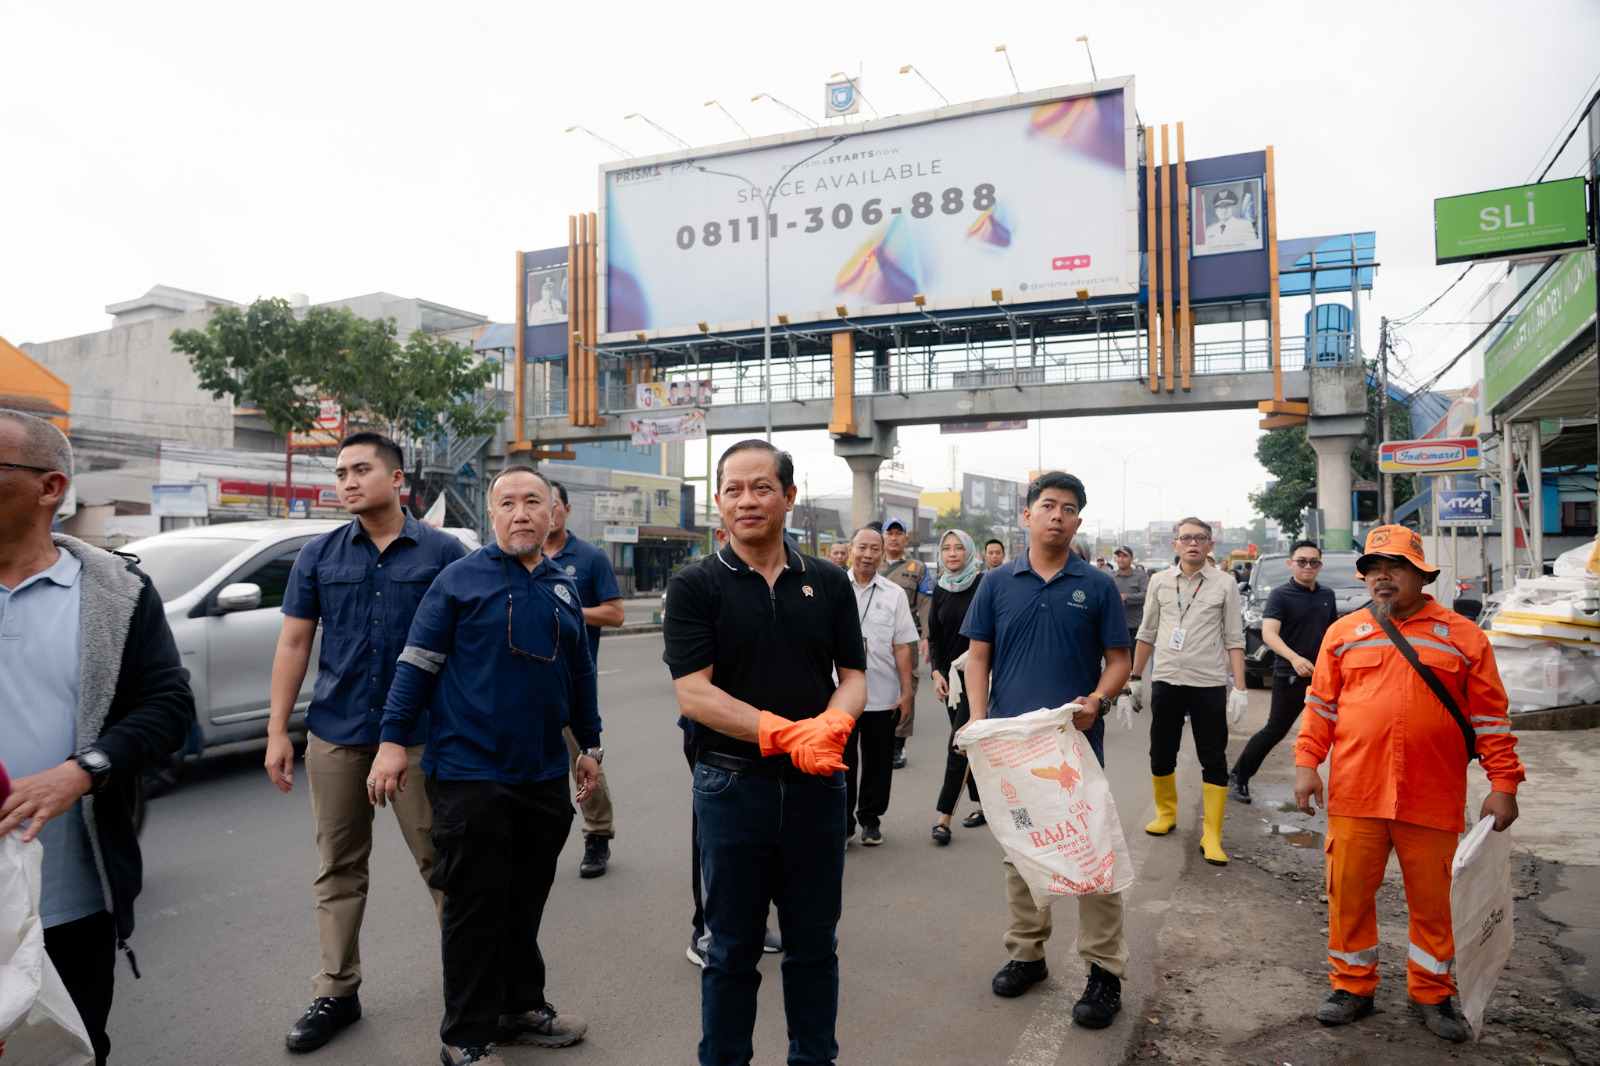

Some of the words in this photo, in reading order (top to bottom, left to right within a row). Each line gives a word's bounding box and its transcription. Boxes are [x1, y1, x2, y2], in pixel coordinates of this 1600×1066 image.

[737, 180, 806, 204] SPACE
[815, 159, 942, 193] AVAILABLE
[676, 183, 996, 250] 08111-306-888
[1502, 232, 1530, 241] Laundry
[1531, 227, 1567, 236] Indonesia
[1398, 449, 1461, 462] Indomaret
[1068, 799, 1085, 815] CAP
[1029, 820, 1079, 848] RAJA
[1057, 838, 1079, 852] Berat
